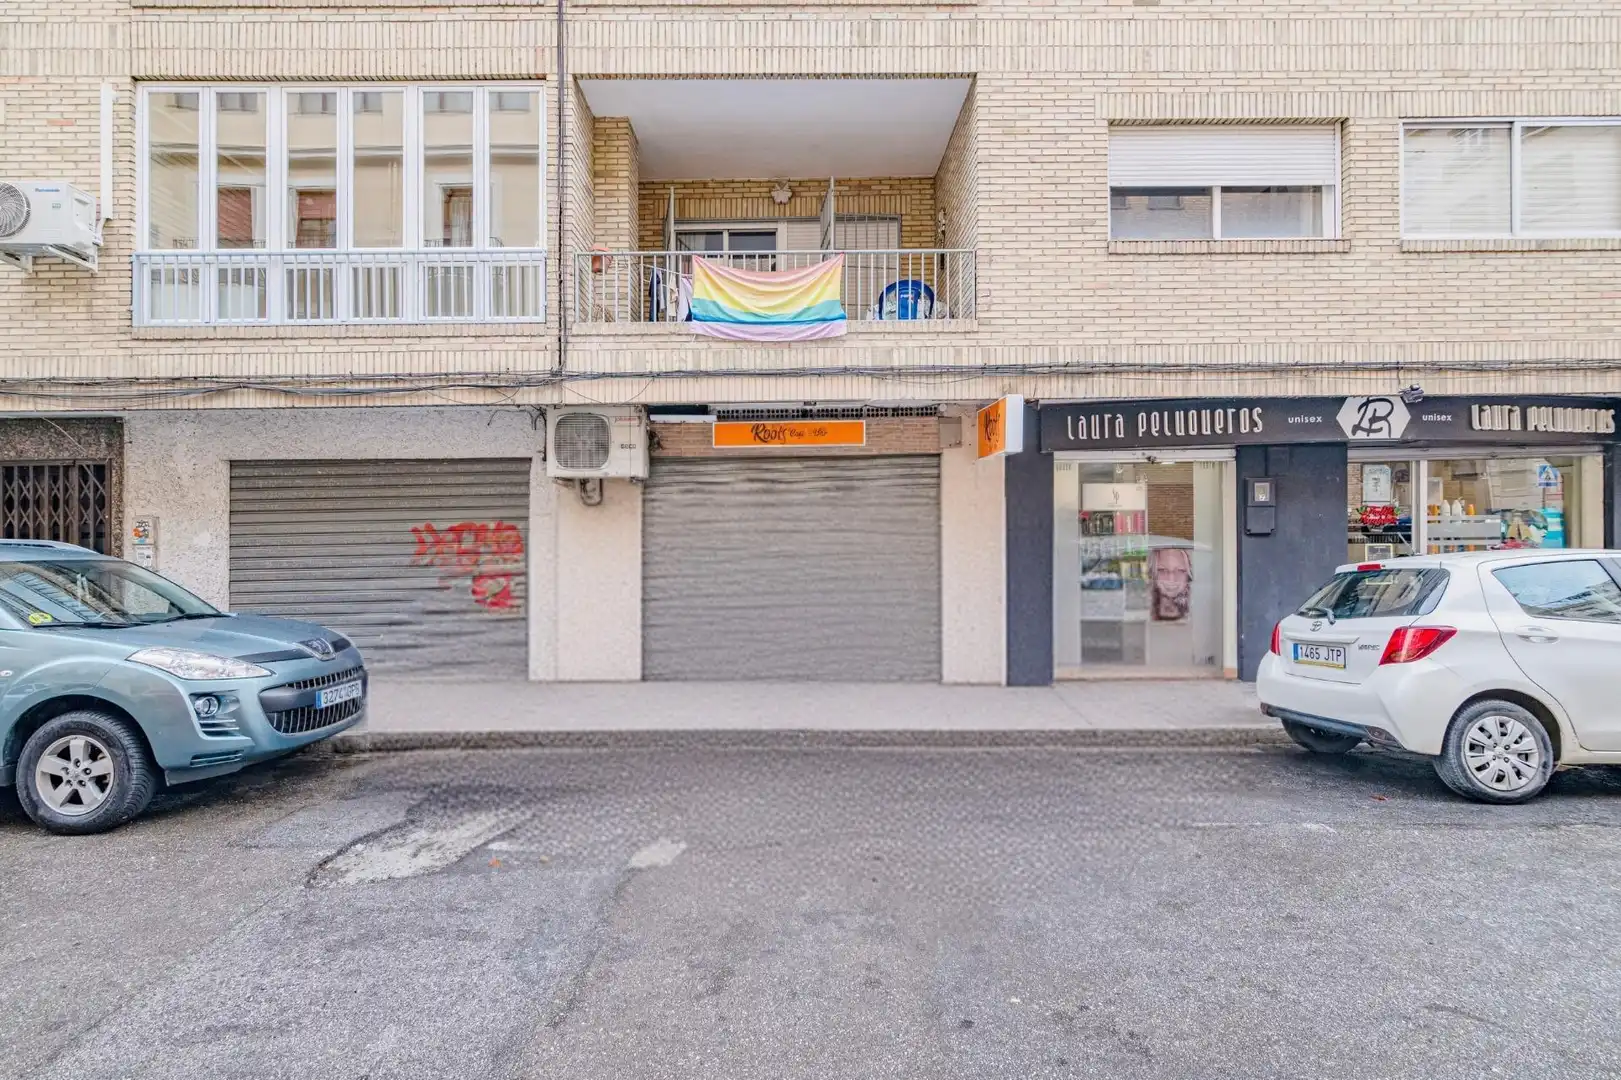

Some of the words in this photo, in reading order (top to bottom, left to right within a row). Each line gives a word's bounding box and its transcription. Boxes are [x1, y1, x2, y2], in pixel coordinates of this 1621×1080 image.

[1288, 415, 1322, 424] unisex
[1422, 412, 1452, 422] unisex
[751, 422, 787, 445] Roots
[1299, 646, 1321, 661] 1465
[1324, 646, 1342, 662] JTP
